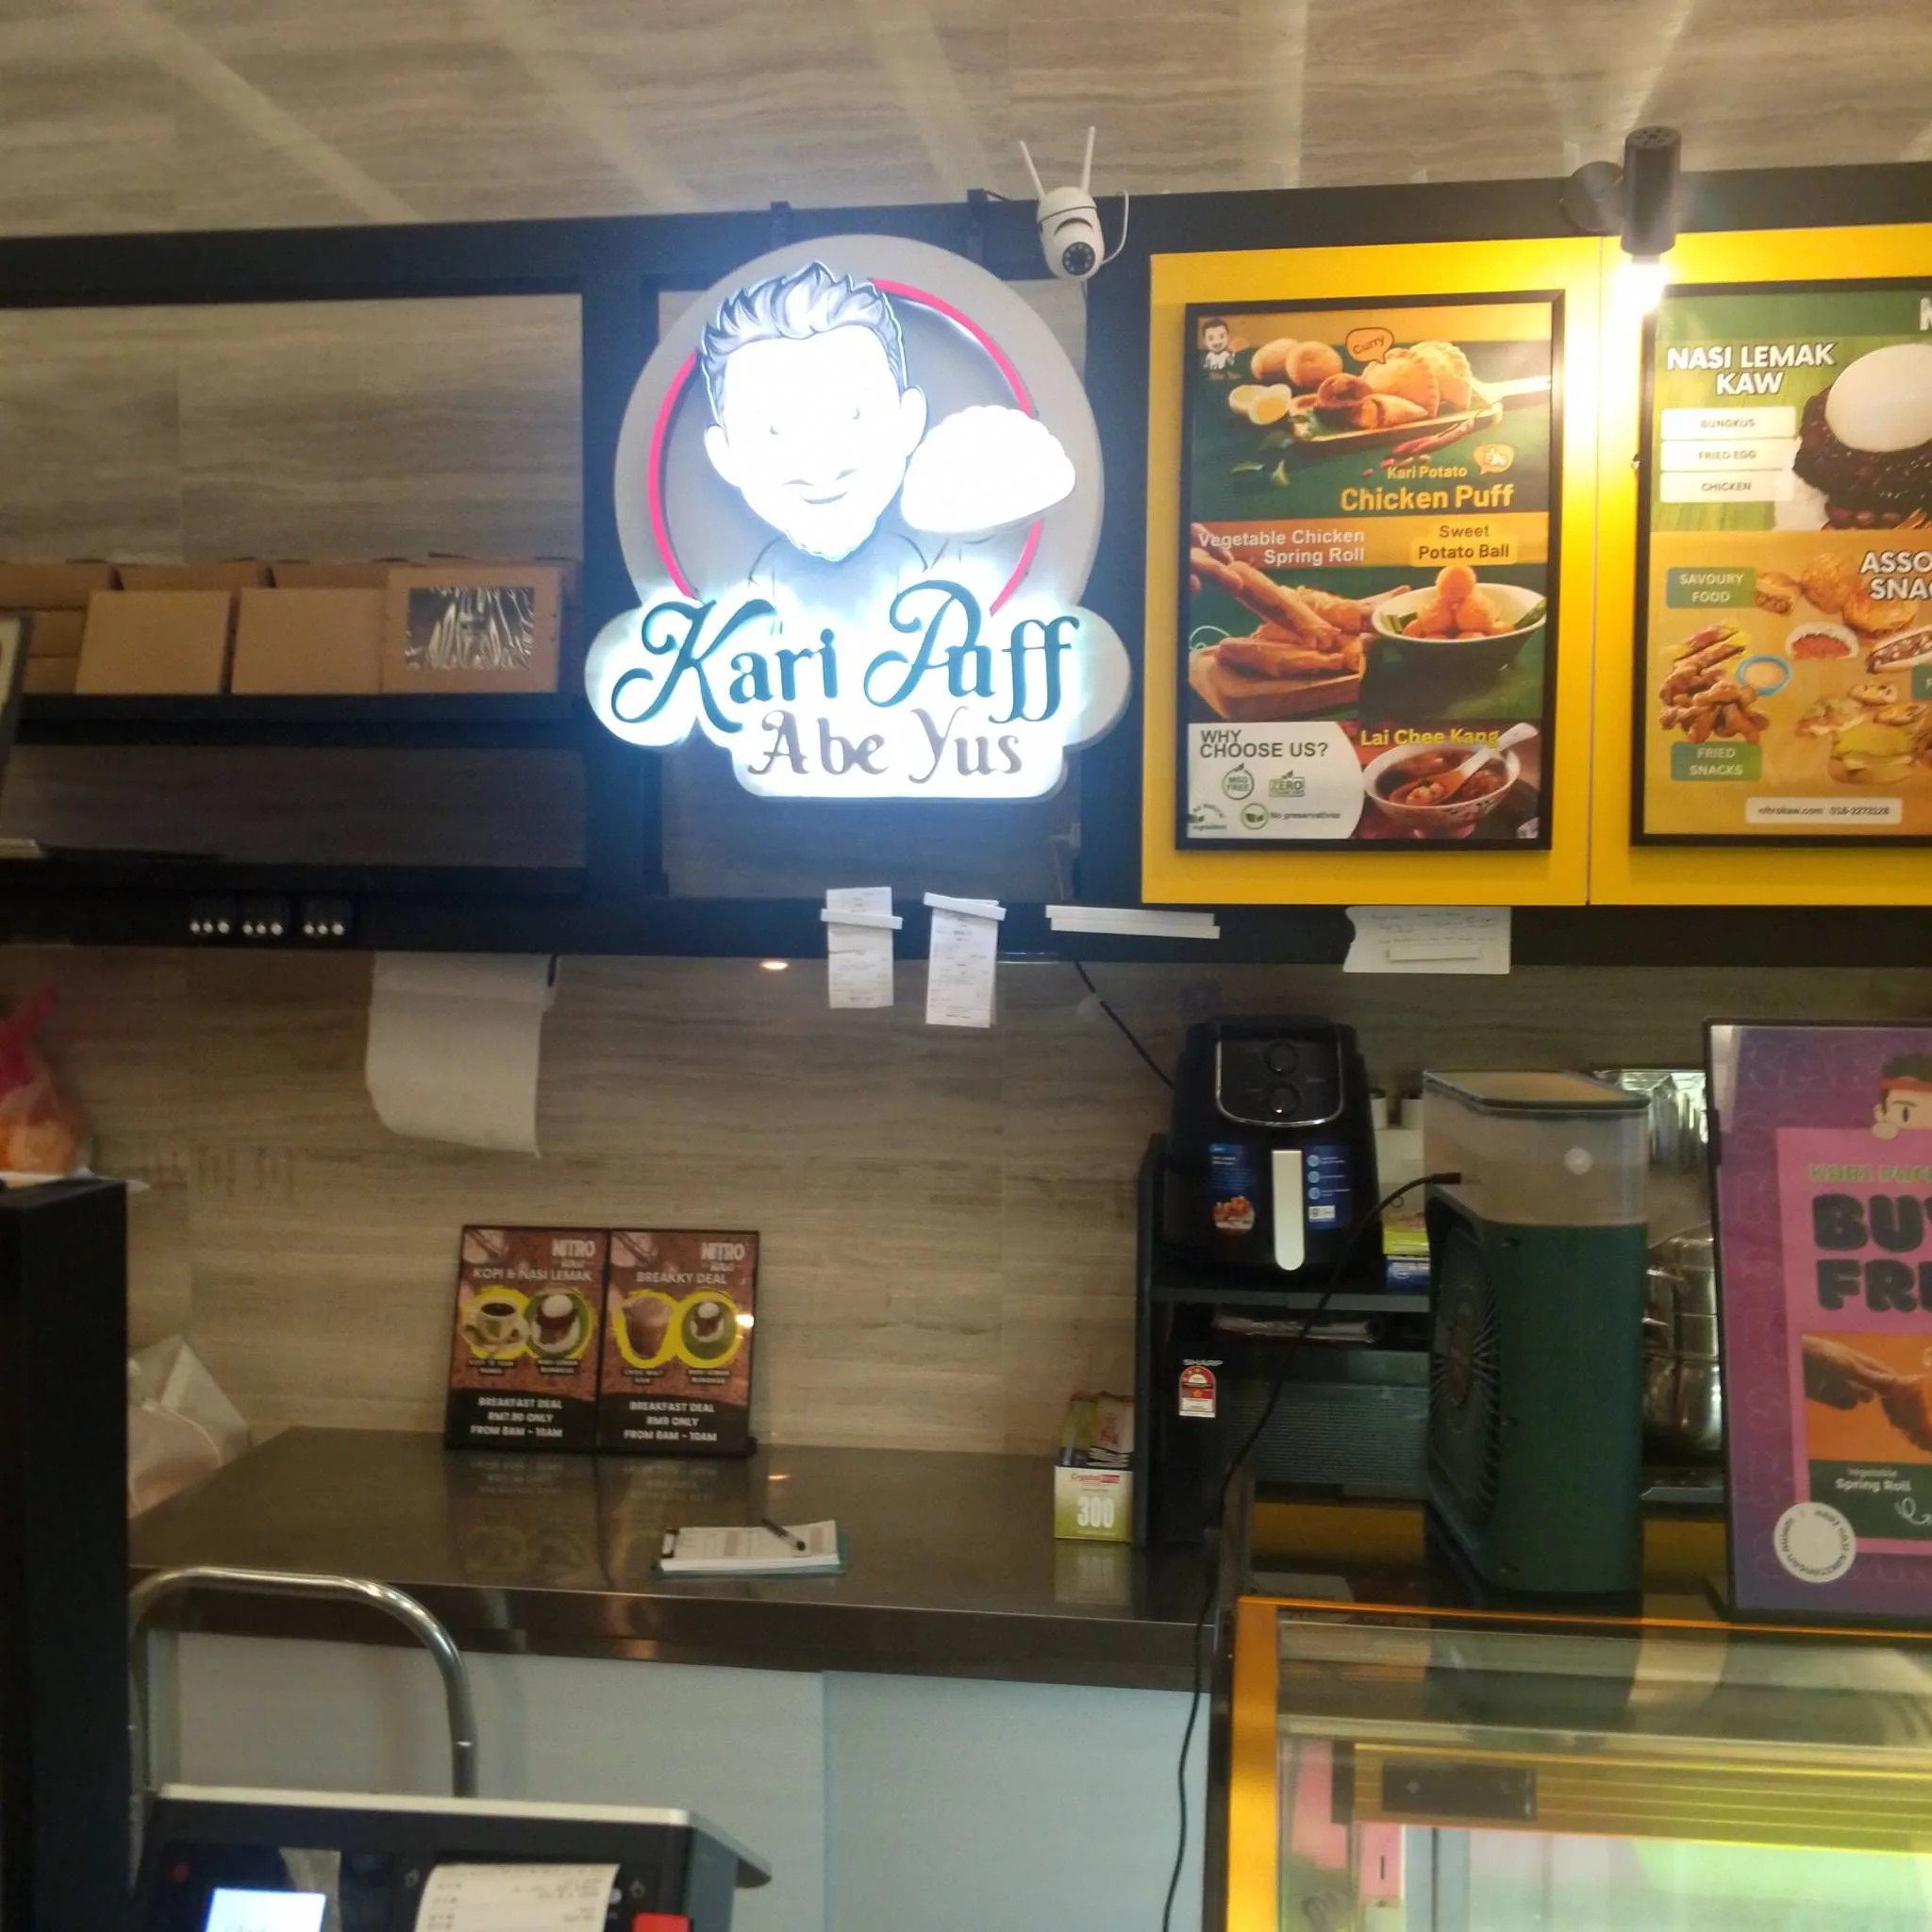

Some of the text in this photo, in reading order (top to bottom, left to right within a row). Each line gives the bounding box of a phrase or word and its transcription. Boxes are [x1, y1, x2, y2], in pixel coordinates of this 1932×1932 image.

[1353, 335, 1386, 355] Curry
[1667, 341, 1837, 371] NASI LEMAK
[1716, 372, 1784, 395] KAW
[1700, 418, 1756, 428] BUNGKUS
[1698, 450, 1757, 460] FRIED EGG
[1387, 465, 1468, 479] Kari Potato
[1701, 481, 1752, 491] CHICKEN
[1341, 484, 1514, 512] Chicken Puff
[1199, 529, 1365, 550] Vegetable Chicken
[1439, 525, 1490, 540] Sweet
[1263, 547, 1365, 568] Spring Roll
[1418, 543, 1509, 559] Potato Ball
[1679, 573, 1744, 586] SAVOURY
[1870, 576, 1932, 601] SNA
[1691, 591, 1731, 603] FOOD
[610, 579, 1080, 733] Kari Puff
[1200, 729, 1241, 743] WHY
[1361, 728, 1500, 749] Lai Chee Kang
[747, 706, 1023, 784] Abe Yus
[1200, 741, 1328, 758] CHOOSE US?
[1697, 747, 1737, 758] FRIED
[1689, 764, 1744, 775] SNACKS
[552, 1239, 596, 1257] NITRO
[701, 1241, 745, 1261] NITRO
[696, 1273, 728, 1285] DEAL
[478, 1396, 563, 1410] BREAKFAST DEAL
[629, 1401, 715, 1413] BREAKFAST DEAL
[525, 1412, 554, 1424] ONLY
[672, 1416, 700, 1427] ONLY
[470, 1425, 501, 1437] FROM
[624, 1429, 654, 1441] FROM
[1835, 1477, 1912, 1493] Spring Roll
[1077, 1495, 1114, 1528] 300
